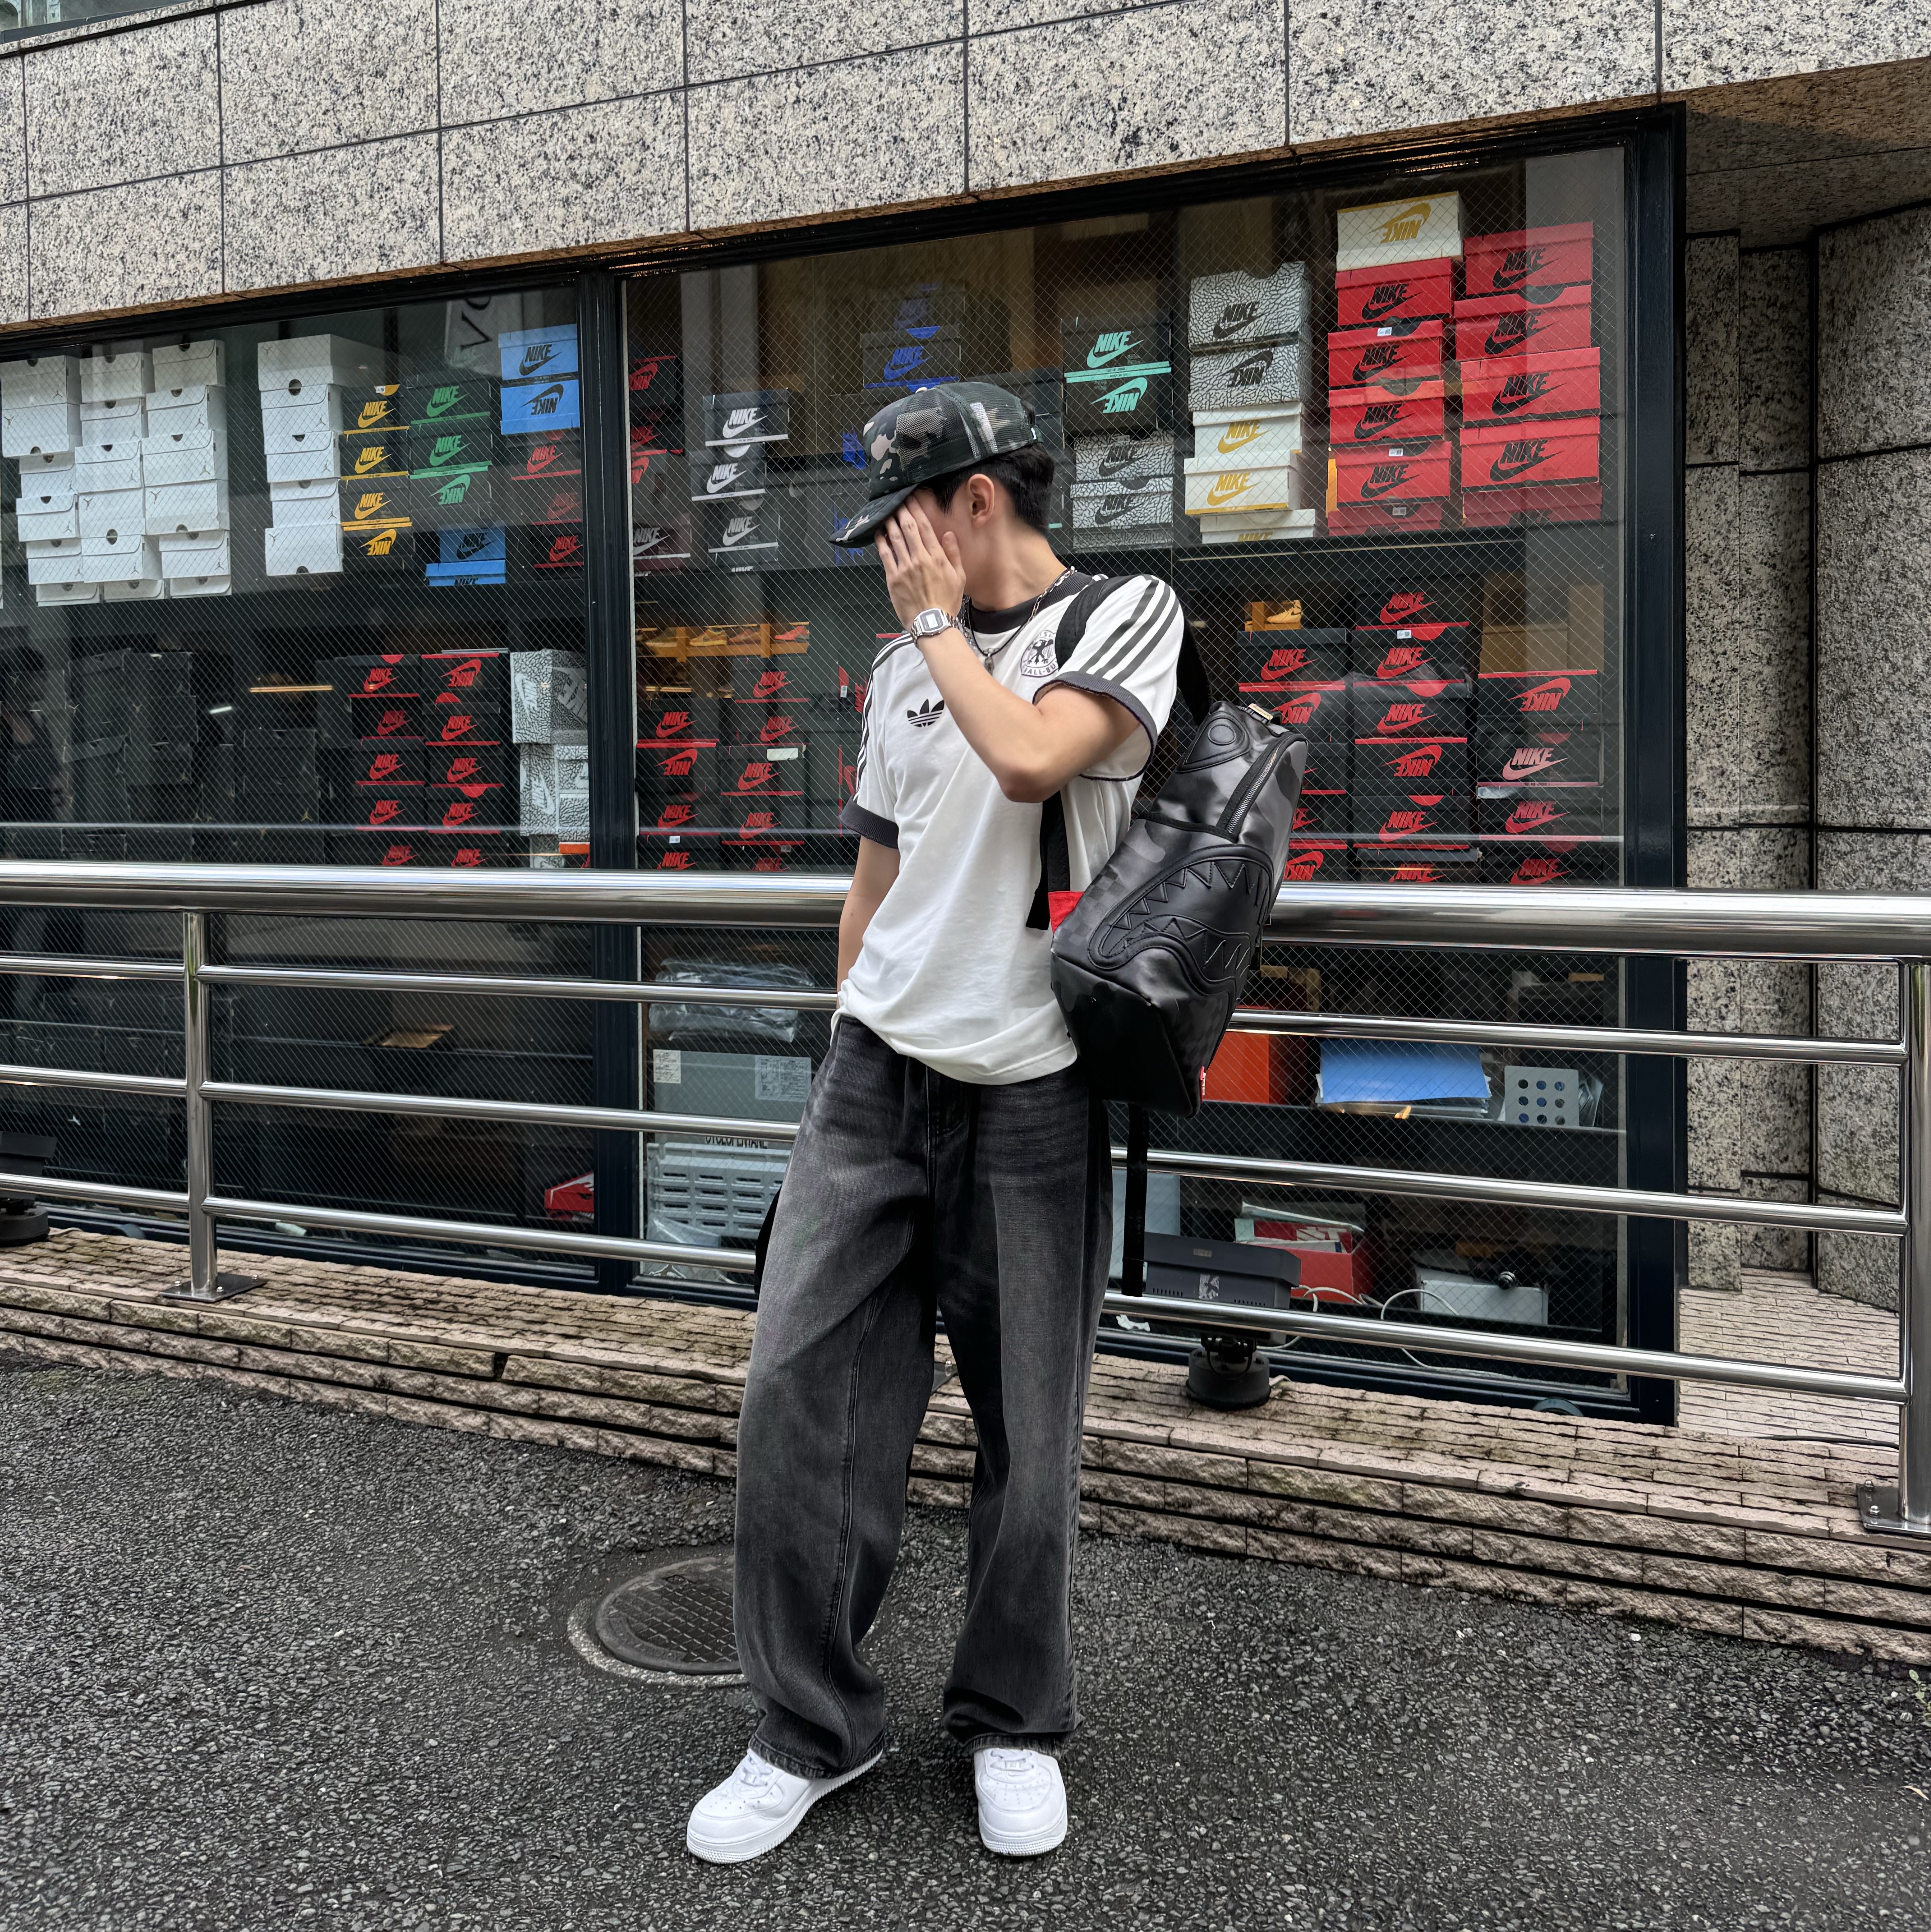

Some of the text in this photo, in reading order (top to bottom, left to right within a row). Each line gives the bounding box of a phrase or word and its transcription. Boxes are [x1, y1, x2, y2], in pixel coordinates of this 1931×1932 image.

[1382, 221, 1421, 243] NIKE
[1503, 249, 1546, 271] NIKE
[1371, 285, 1409, 304] NIKE
[1495, 312, 1541, 336] NIKE
[1094, 331, 1131, 353] NIKE
[524, 344, 552, 363] NIKE
[892, 347, 923, 365] NIKE
[1362, 345, 1398, 366] NIKE
[1504, 373, 1550, 396] NIKE
[433, 386, 459, 403] NIKE
[364, 401, 387, 416] NIKE
[531, 398, 557, 415] NIKE
[1103, 393, 1138, 413] NIKE
[729, 408, 759, 424] NIKE
[1363, 405, 1402, 423] NIKE
[1225, 421, 1260, 439] NIKE
[436, 435, 462, 453] NIKE
[1501, 440, 1548, 463] NIKE
[362, 446, 384, 462] NIKE
[532, 445, 556, 461] NIKE
[712, 463, 738, 480] NIKE
[1371, 465, 1409, 484] NIKE
[1215, 473, 1250, 491] NIKE
[361, 492, 384, 508] NIKE
[439, 487, 465, 504] NIKE
[728, 517, 753, 532] NIKE
[460, 532, 488, 548] NIKE
[555, 535, 578, 549] NIKE
[635, 528, 660, 542] NIKE
[367, 541, 390, 555] NIKE
[1388, 592, 1424, 610] NIKE
[1270, 649, 1306, 666] NIKE
[1385, 647, 1424, 665] NIKE
[370, 668, 392, 681] NIKE
[1023, 663, 1056, 675] ALL-BU
[447, 671, 475, 687] NIKE
[761, 671, 787, 685] NIKE
[1519, 693, 1561, 711] NIKE
[382, 711, 405, 724] NIKE
[663, 712, 689, 725] NIKE
[1387, 704, 1424, 721] NIKE
[448, 716, 472, 730] NIKE
[767, 716, 793, 730] NIKE
[375, 754, 399, 769] NIKE
[1512, 748, 1553, 765] NIKE
[453, 758, 477, 772] NIKE
[664, 761, 693, 775] NIKE
[744, 763, 773, 777] NIKE
[1394, 760, 1432, 776] NIKE
[375, 800, 398, 814] NIKE
[449, 803, 473, 817] NIKE
[663, 805, 691, 819] NIKE
[1515, 801, 1555, 818] NIKE
[746, 813, 774, 826] NIKE
[1388, 811, 1425, 829] NIKE
[388, 846, 411, 859] NIKE
[457, 849, 481, 863] NIKE
[662, 853, 689, 867] NIKE
[1284, 865, 1315, 880] NIK
[1396, 864, 1433, 880] NIKE
[1518, 859, 1559, 876] NIKE
